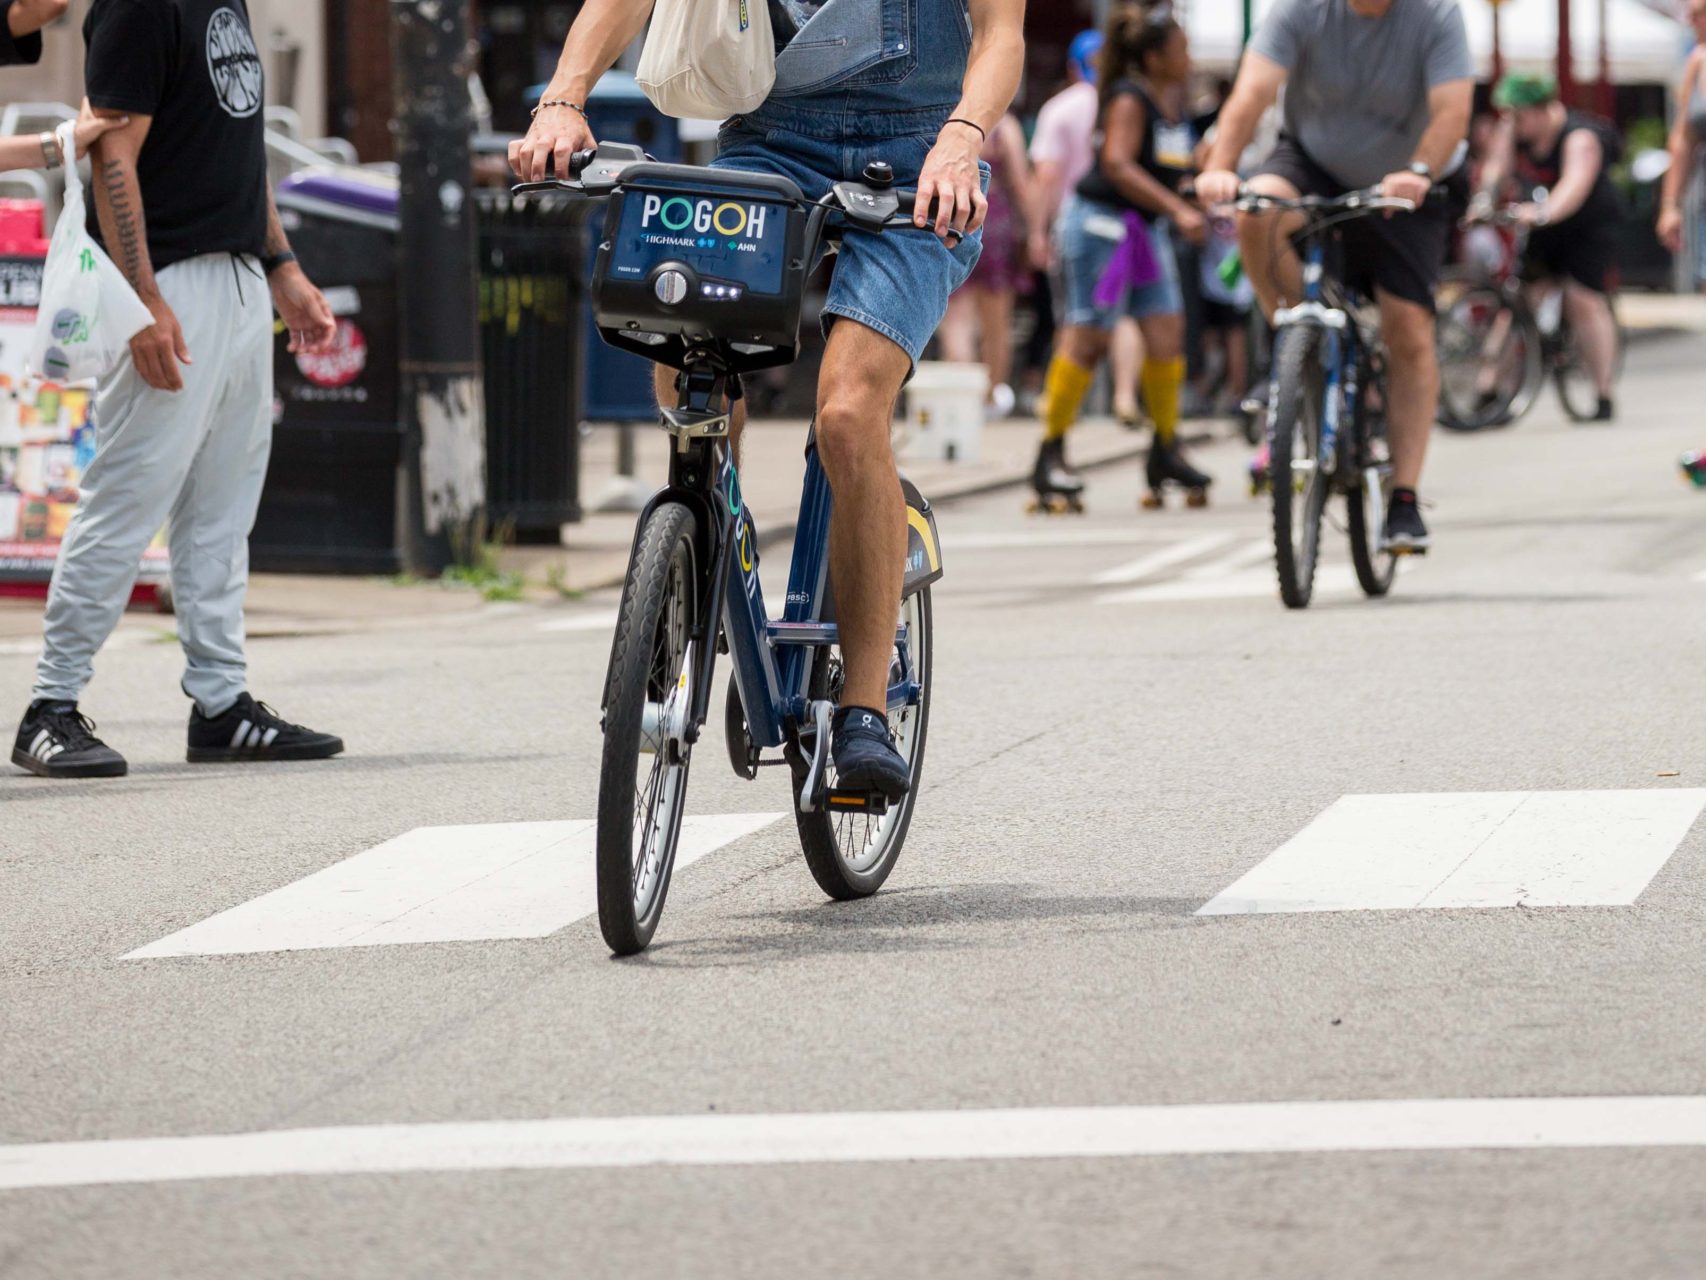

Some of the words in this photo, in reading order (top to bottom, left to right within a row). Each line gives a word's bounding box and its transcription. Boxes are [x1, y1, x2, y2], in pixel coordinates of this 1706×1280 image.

[641, 194, 766, 239] POGOH
[644, 233, 696, 248] HIGHMARK
[737, 243, 757, 253] AHN
